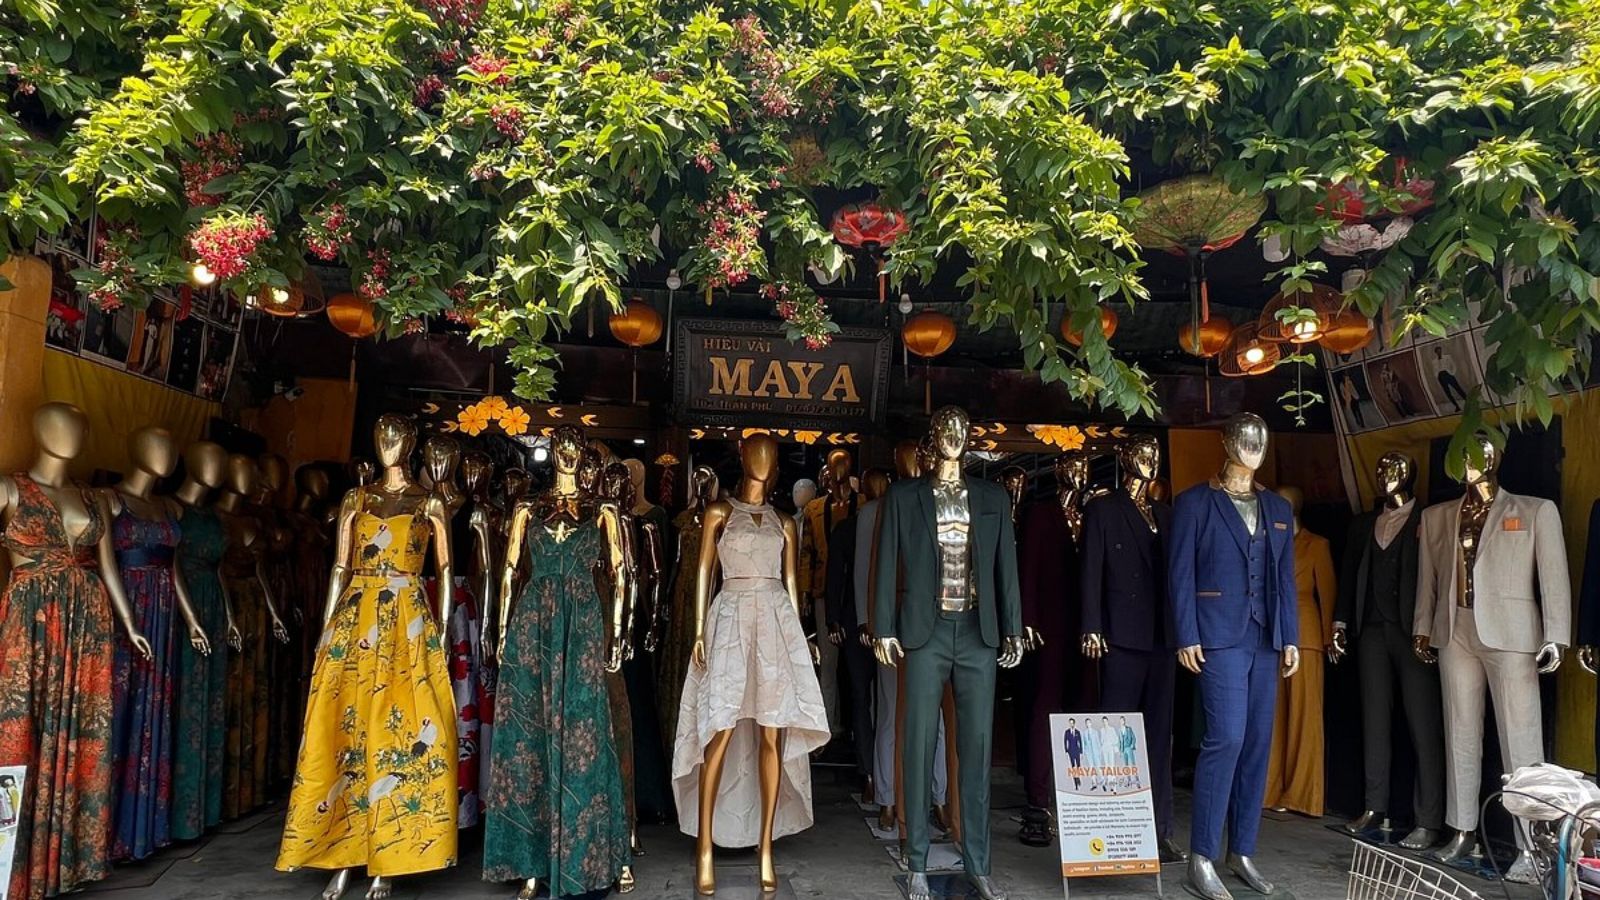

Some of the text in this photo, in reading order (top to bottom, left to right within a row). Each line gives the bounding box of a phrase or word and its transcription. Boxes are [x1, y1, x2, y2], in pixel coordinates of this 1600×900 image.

[709, 357, 860, 402] MAYA
[1067, 766, 1139, 777] MAYA TAILOR
